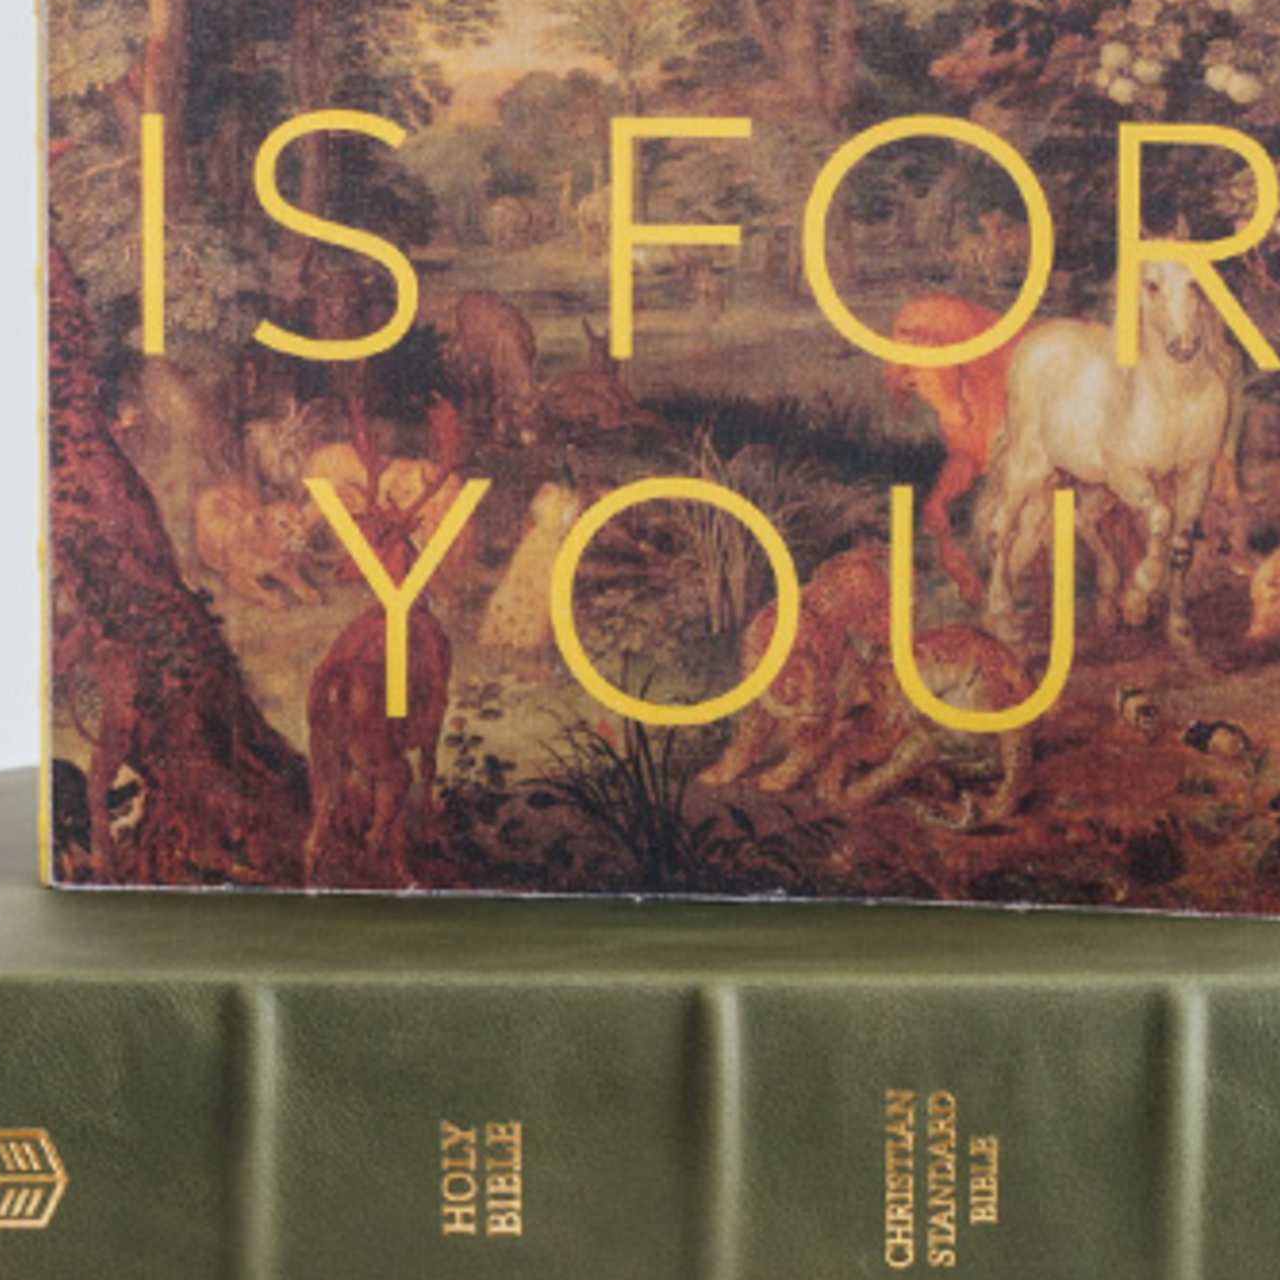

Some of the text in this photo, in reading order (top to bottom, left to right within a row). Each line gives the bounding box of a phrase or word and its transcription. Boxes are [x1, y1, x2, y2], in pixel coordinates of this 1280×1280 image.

[140, 110, 421, 363] IS
[303, 474, 1076, 733] YOU
[441, 1121, 477, 1236] HOLY
[486, 1120, 522, 1237] BIBLE
[884, 1088, 916, 1270] CHRISTIAN
[927, 1090, 957, 1269] STANDARD
[970, 1135, 999, 1226] BIBLE
